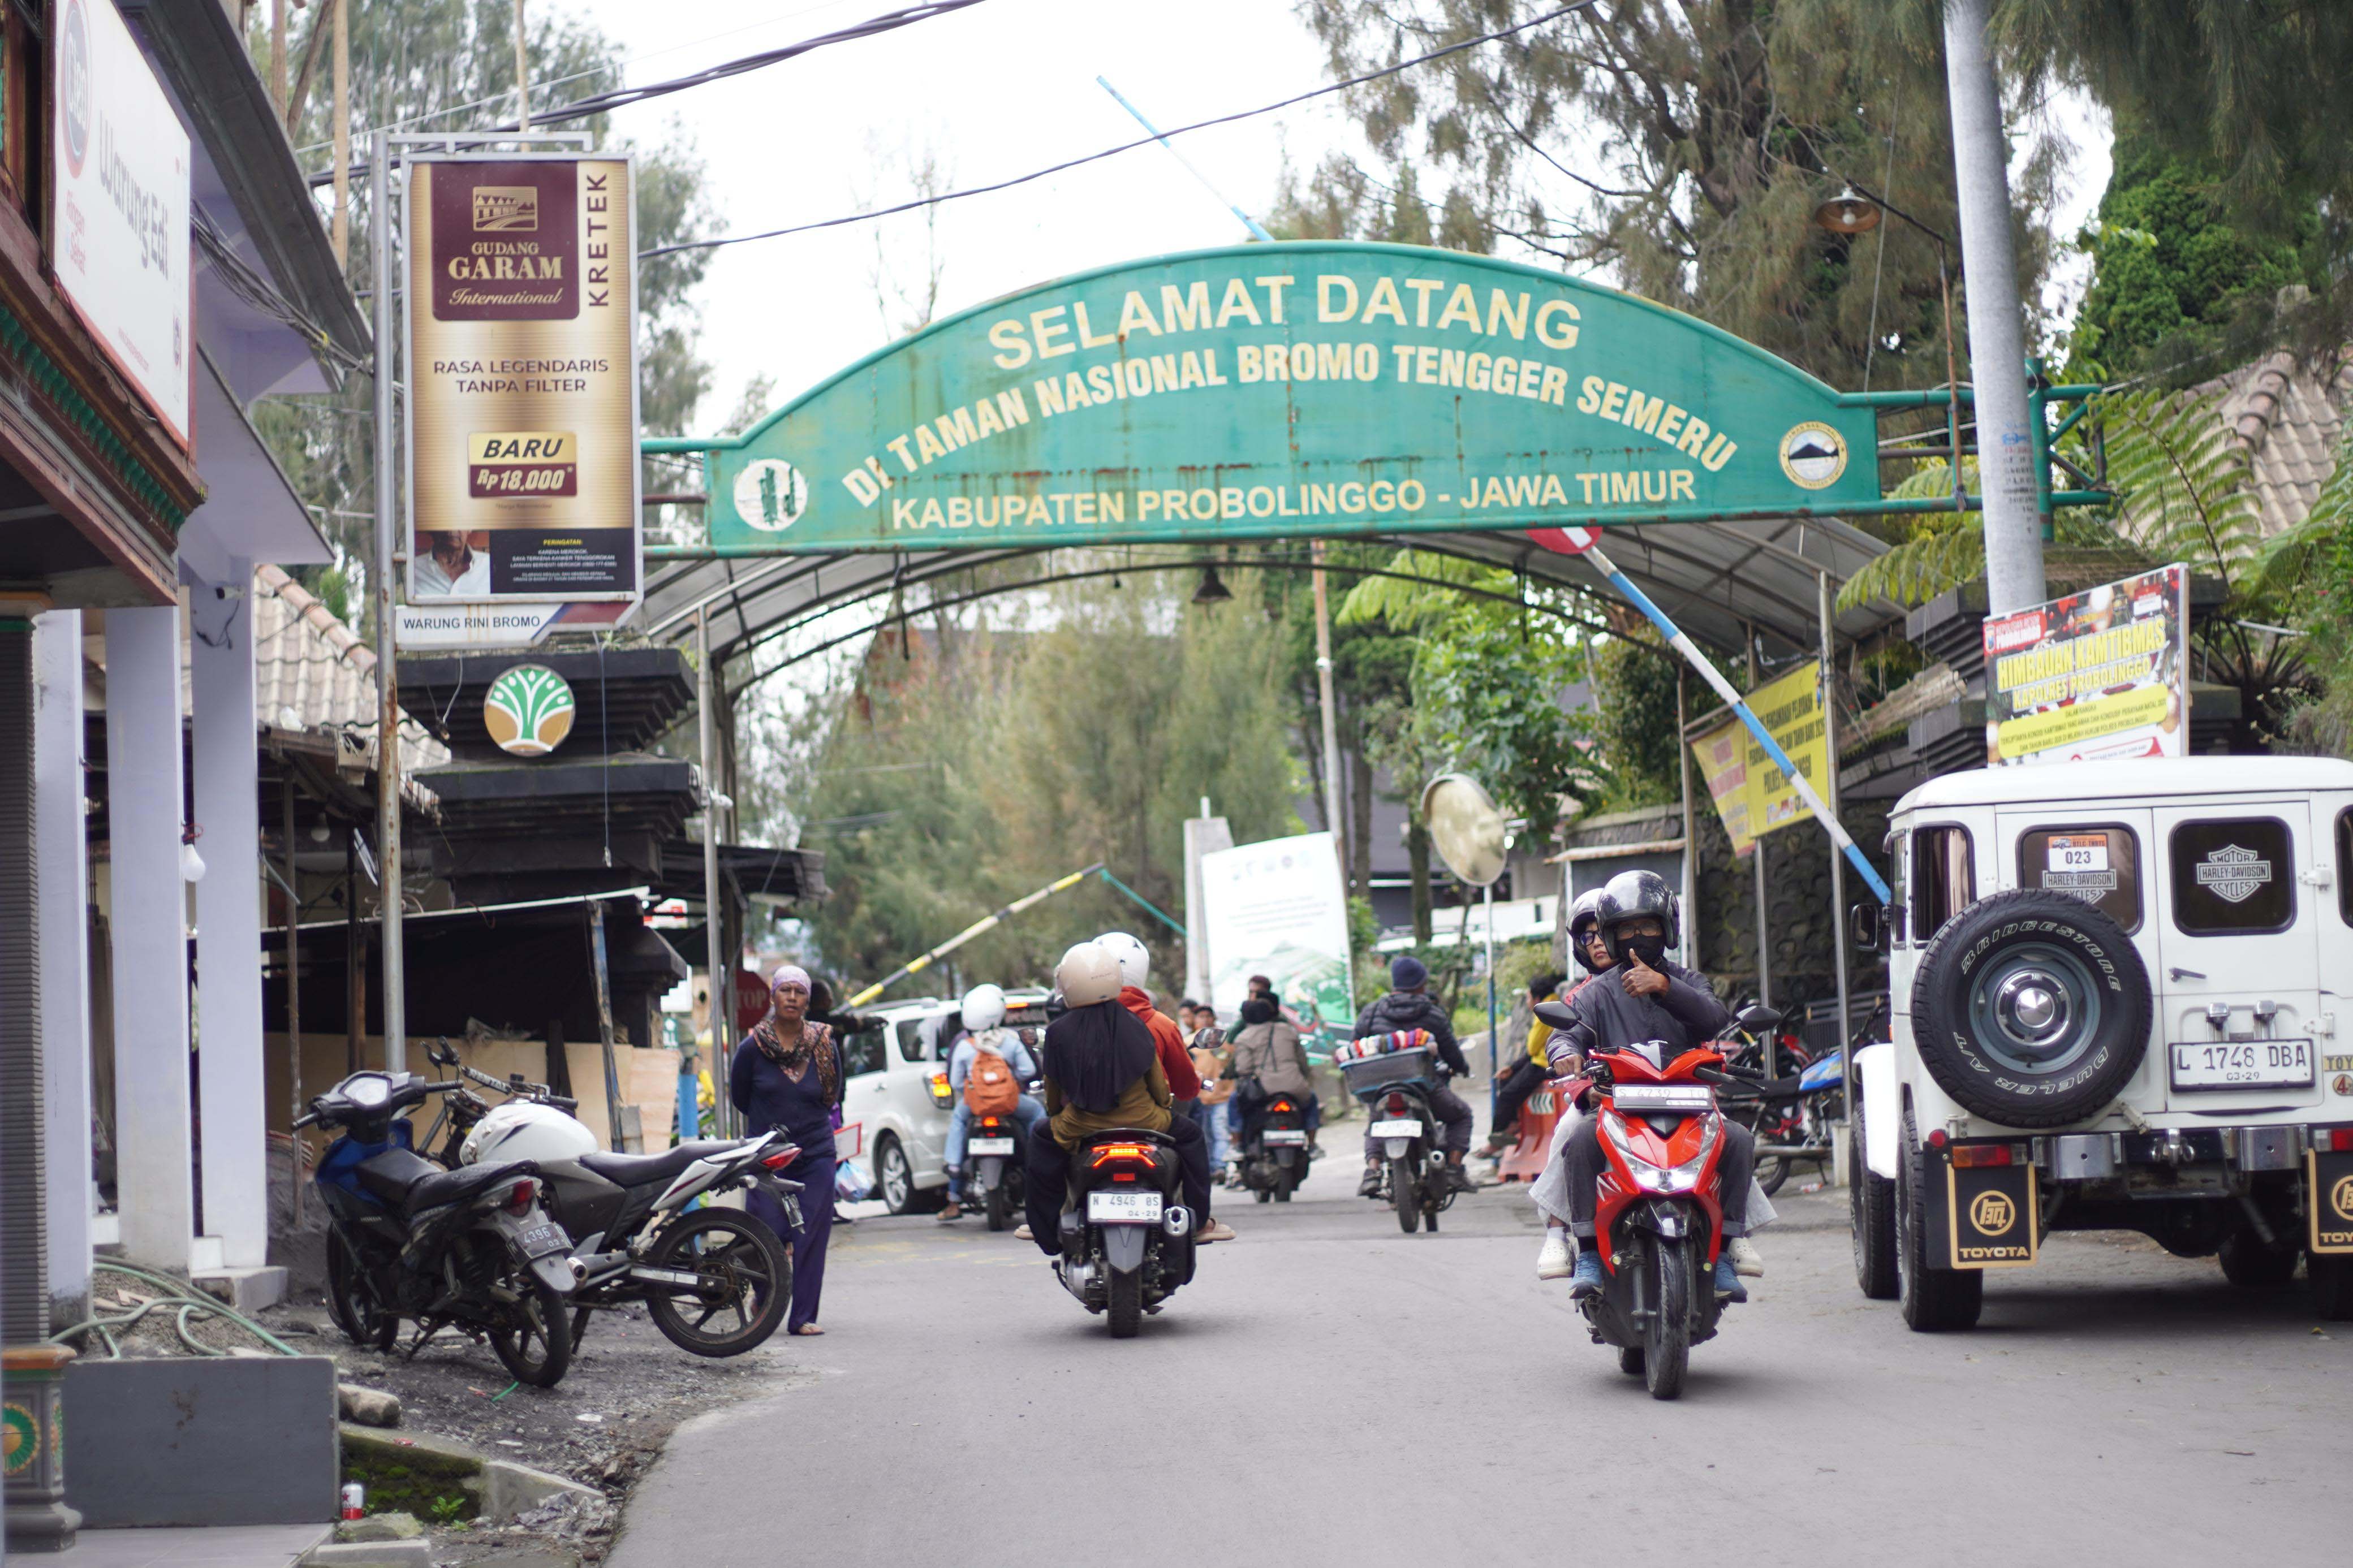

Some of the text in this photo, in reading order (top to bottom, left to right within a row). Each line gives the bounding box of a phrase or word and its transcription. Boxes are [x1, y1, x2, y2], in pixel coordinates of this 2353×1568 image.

[99, 109, 168, 280] Warung Edi
[471, 242, 539, 254] GUDANG
[587, 174, 608, 306] KRETEK
[448, 256, 563, 280] GARAM
[449, 288, 563, 305] International
[988, 275, 1581, 370] SELAMAT DATANG
[434, 360, 609, 374] RASA LEGENDARIS
[456, 379, 586, 392] TANPA FILTER
[842, 343, 1737, 507] DI TAMAN NASIONAL BROMO TENGGER SEMERU
[483, 439, 563, 458] BARU
[892, 490, 1124, 529] KABUPATEN
[1137, 480, 1425, 522] PROBOLINGGO
[1460, 474, 1568, 508] JAWA
[1577, 469, 1696, 504] TIMUR
[404, 616, 540, 629] WARUNG RINI BROMO
[1998, 616, 2166, 691] HIMBAUAN KAMTIBMAS
[2013, 658, 2151, 710] KAPOLRES PROBOLINGGO
[2065, 850, 2091, 864] 023
[2217, 850, 2250, 863] MOTOR
[2048, 873, 2111, 885] HARLEY-DAVIDSON
[2203, 866, 2266, 879] HARLEY-DAVIDSON
[2218, 882, 2252, 897] CYCLES
[1962, 921, 2121, 992] BRIDGESTONE
[1953, 1032, 1990, 1073] A/T
[2177, 1045, 2307, 1070] L 1748 DBA
[1995, 1046, 2109, 1095] DUELER
[1110, 1196, 1136, 1206] 4946
[524, 1226, 551, 1243] 4396
[1959, 1246, 2029, 1258] TOYOTA
